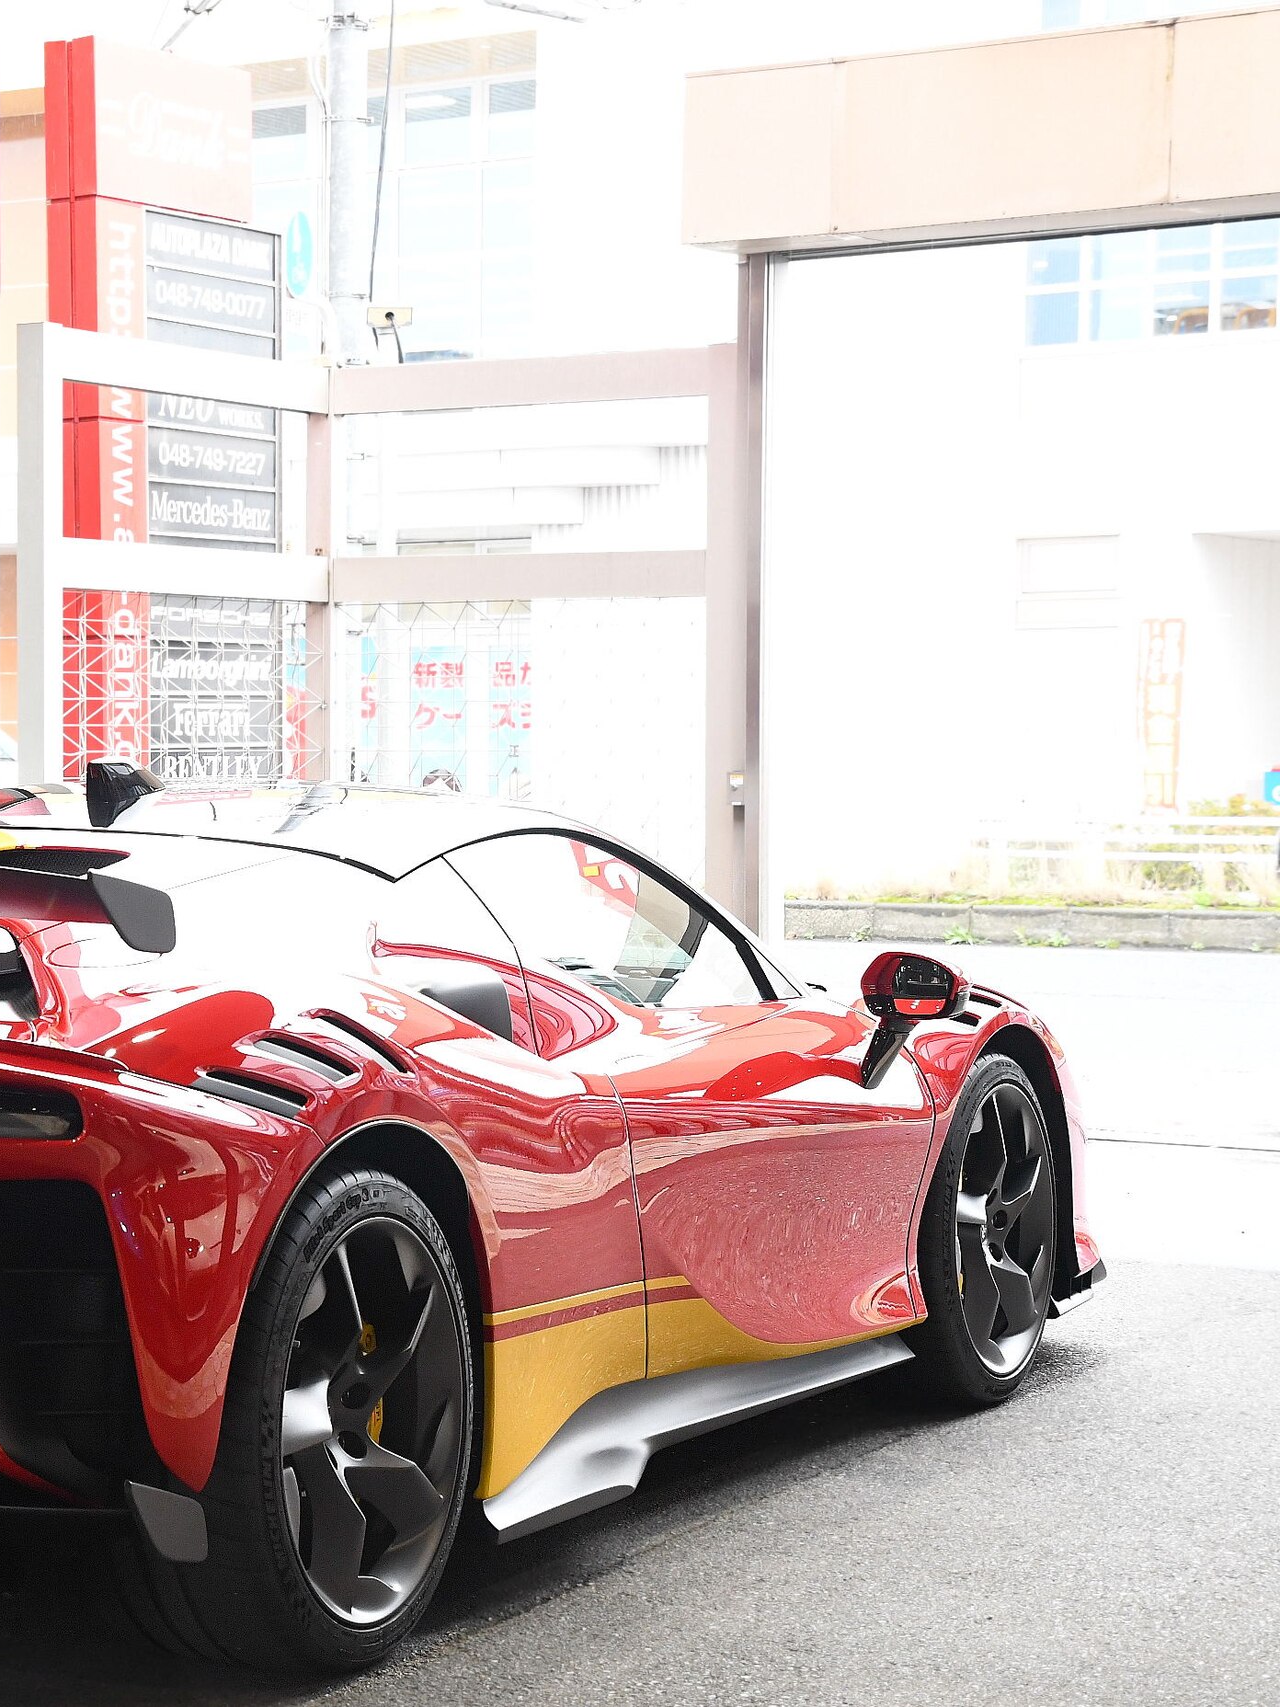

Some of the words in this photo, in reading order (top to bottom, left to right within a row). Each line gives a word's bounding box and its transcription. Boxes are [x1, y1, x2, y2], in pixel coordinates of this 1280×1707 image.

[158, 441, 266, 477] 048-749-7227
[151, 489, 271, 532] Mercedes-Benz
[150, 651, 273, 688] Lamborghini
[173, 702, 251, 737] Ferrari
[162, 755, 263, 780] BENTLEY
